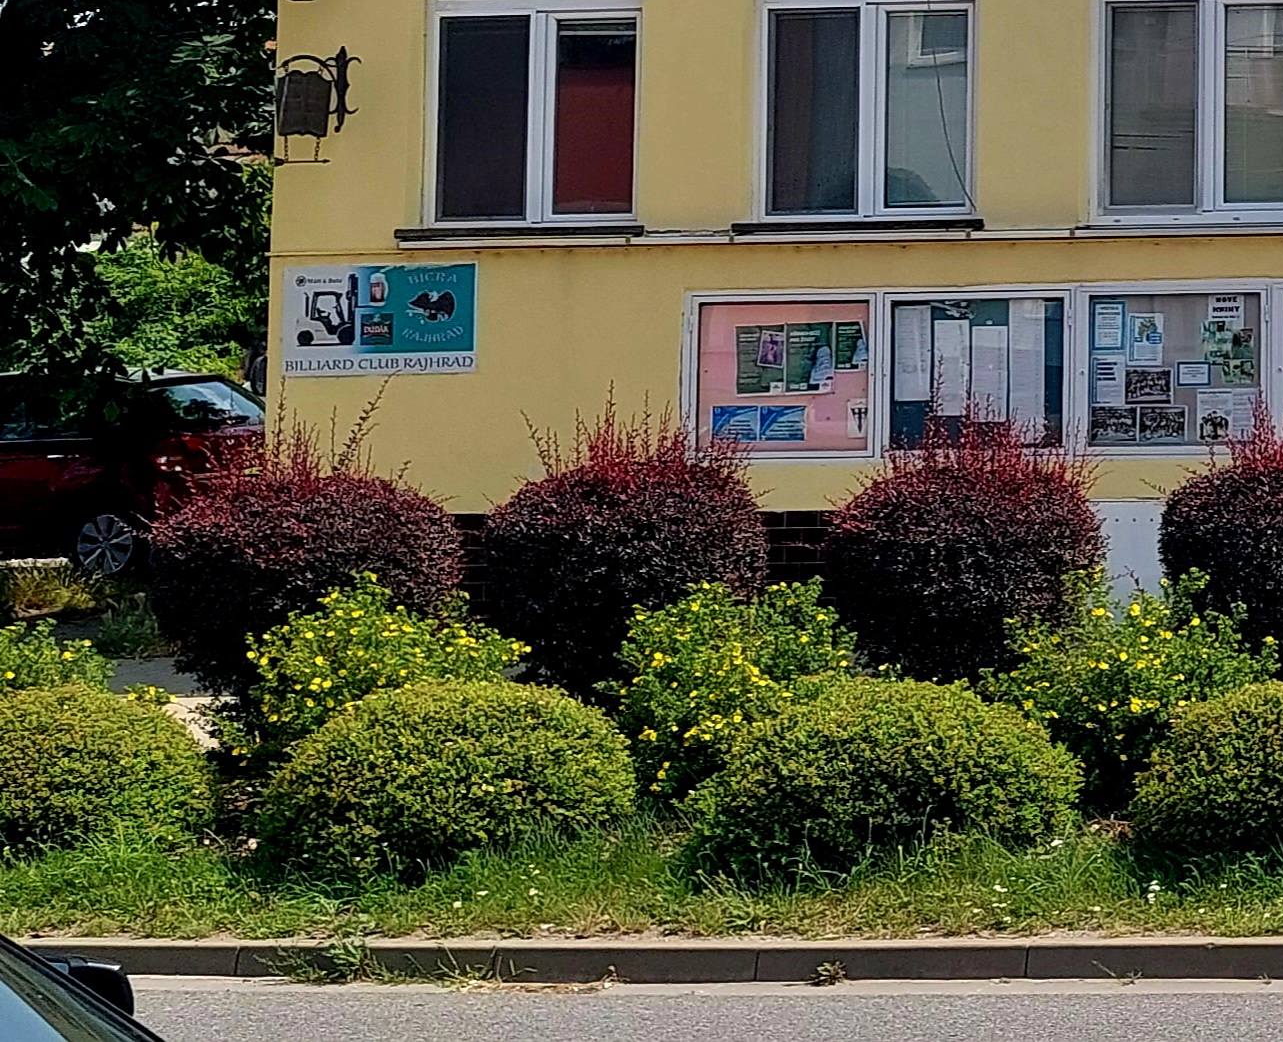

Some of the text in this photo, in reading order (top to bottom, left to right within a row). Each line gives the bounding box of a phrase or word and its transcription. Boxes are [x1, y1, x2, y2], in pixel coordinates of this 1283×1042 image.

[402, 326, 464, 343] RAJHRAD
[285, 356, 474, 372] BILLIARD CLUB RAJHRAD
